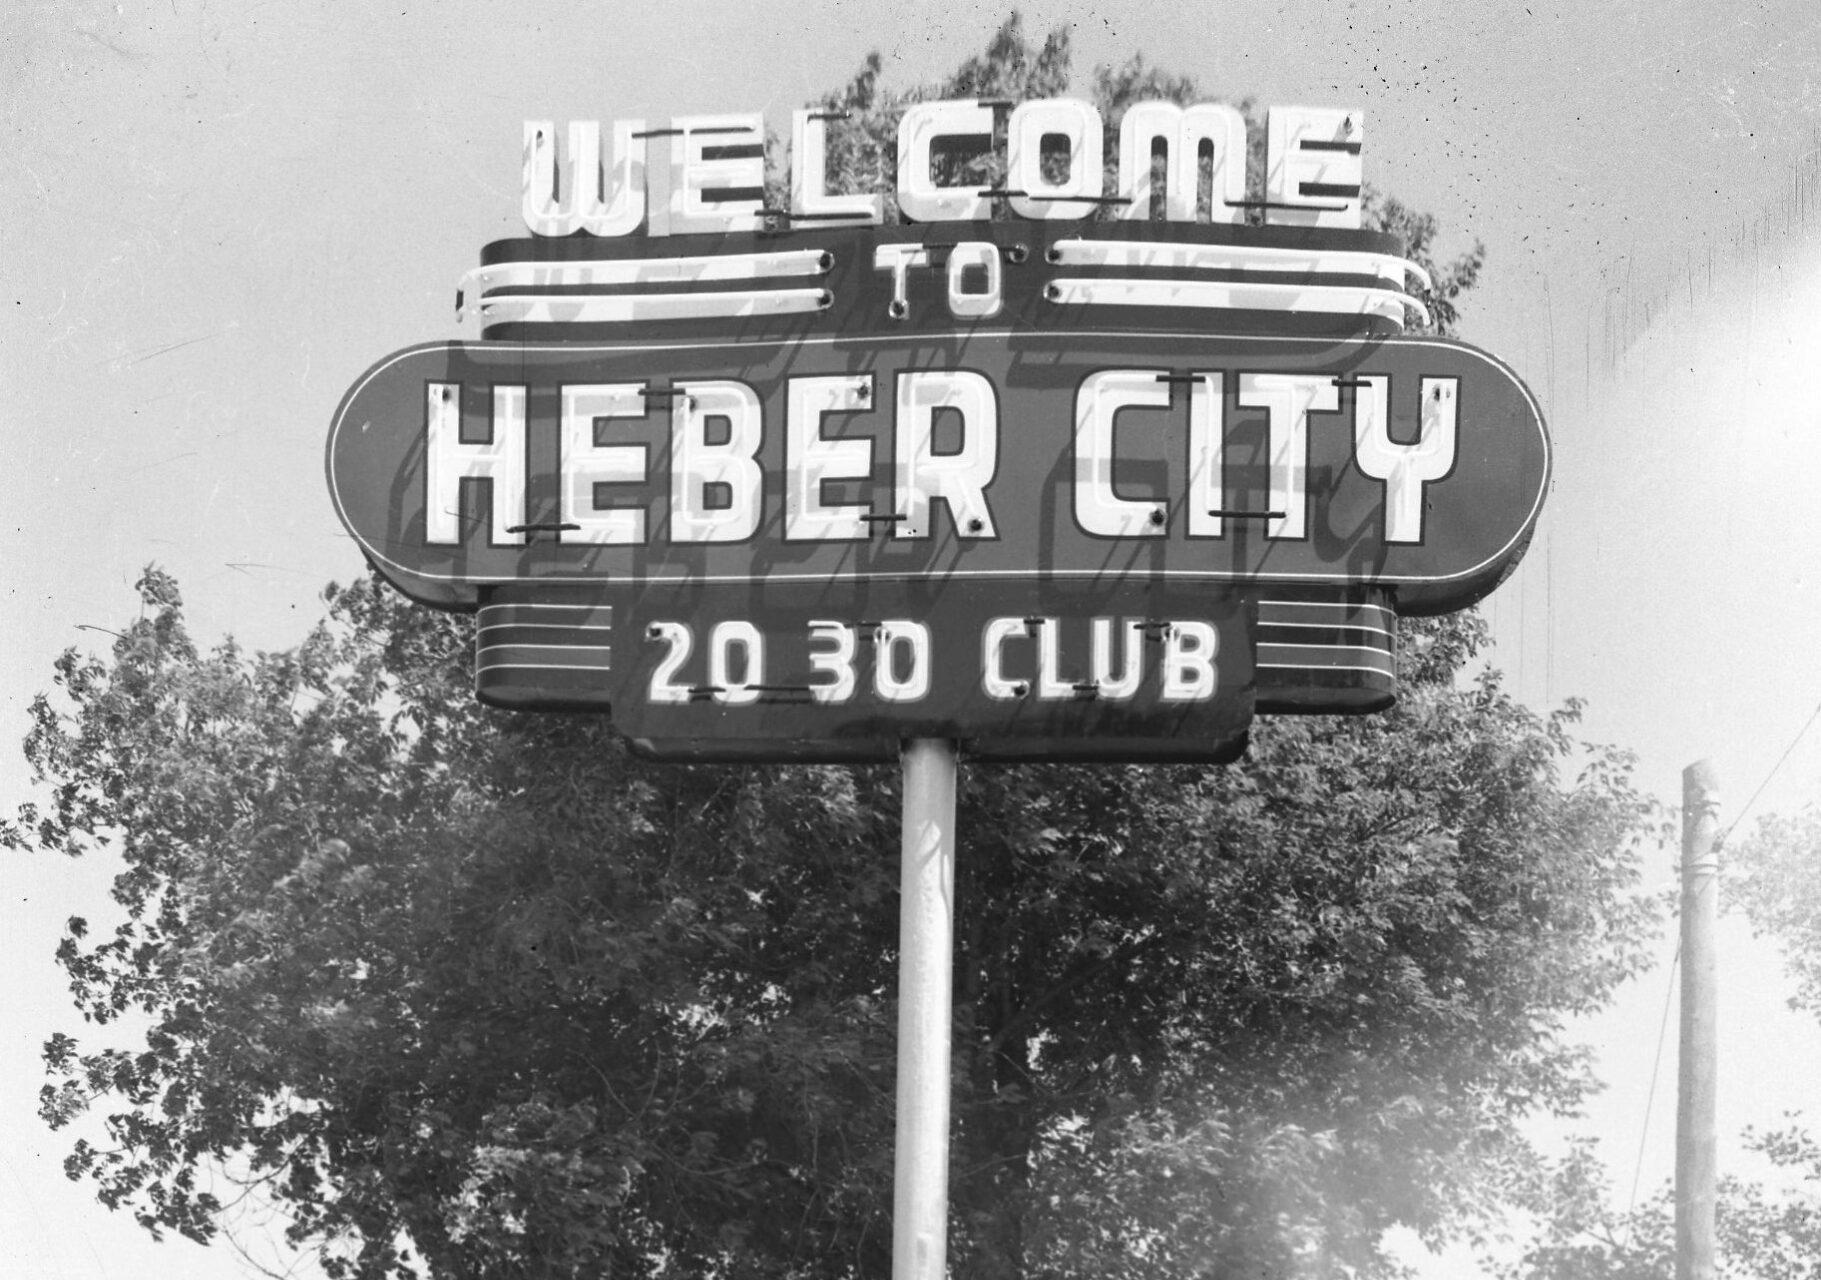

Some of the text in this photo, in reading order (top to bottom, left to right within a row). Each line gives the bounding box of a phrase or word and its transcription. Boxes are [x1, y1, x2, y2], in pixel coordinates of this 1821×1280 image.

[522, 99, 1363, 236] WELCOME
[874, 242, 1001, 318] TO
[425, 368, 1461, 547] HEBER CITY
[981, 617, 1218, 700] CLUB
